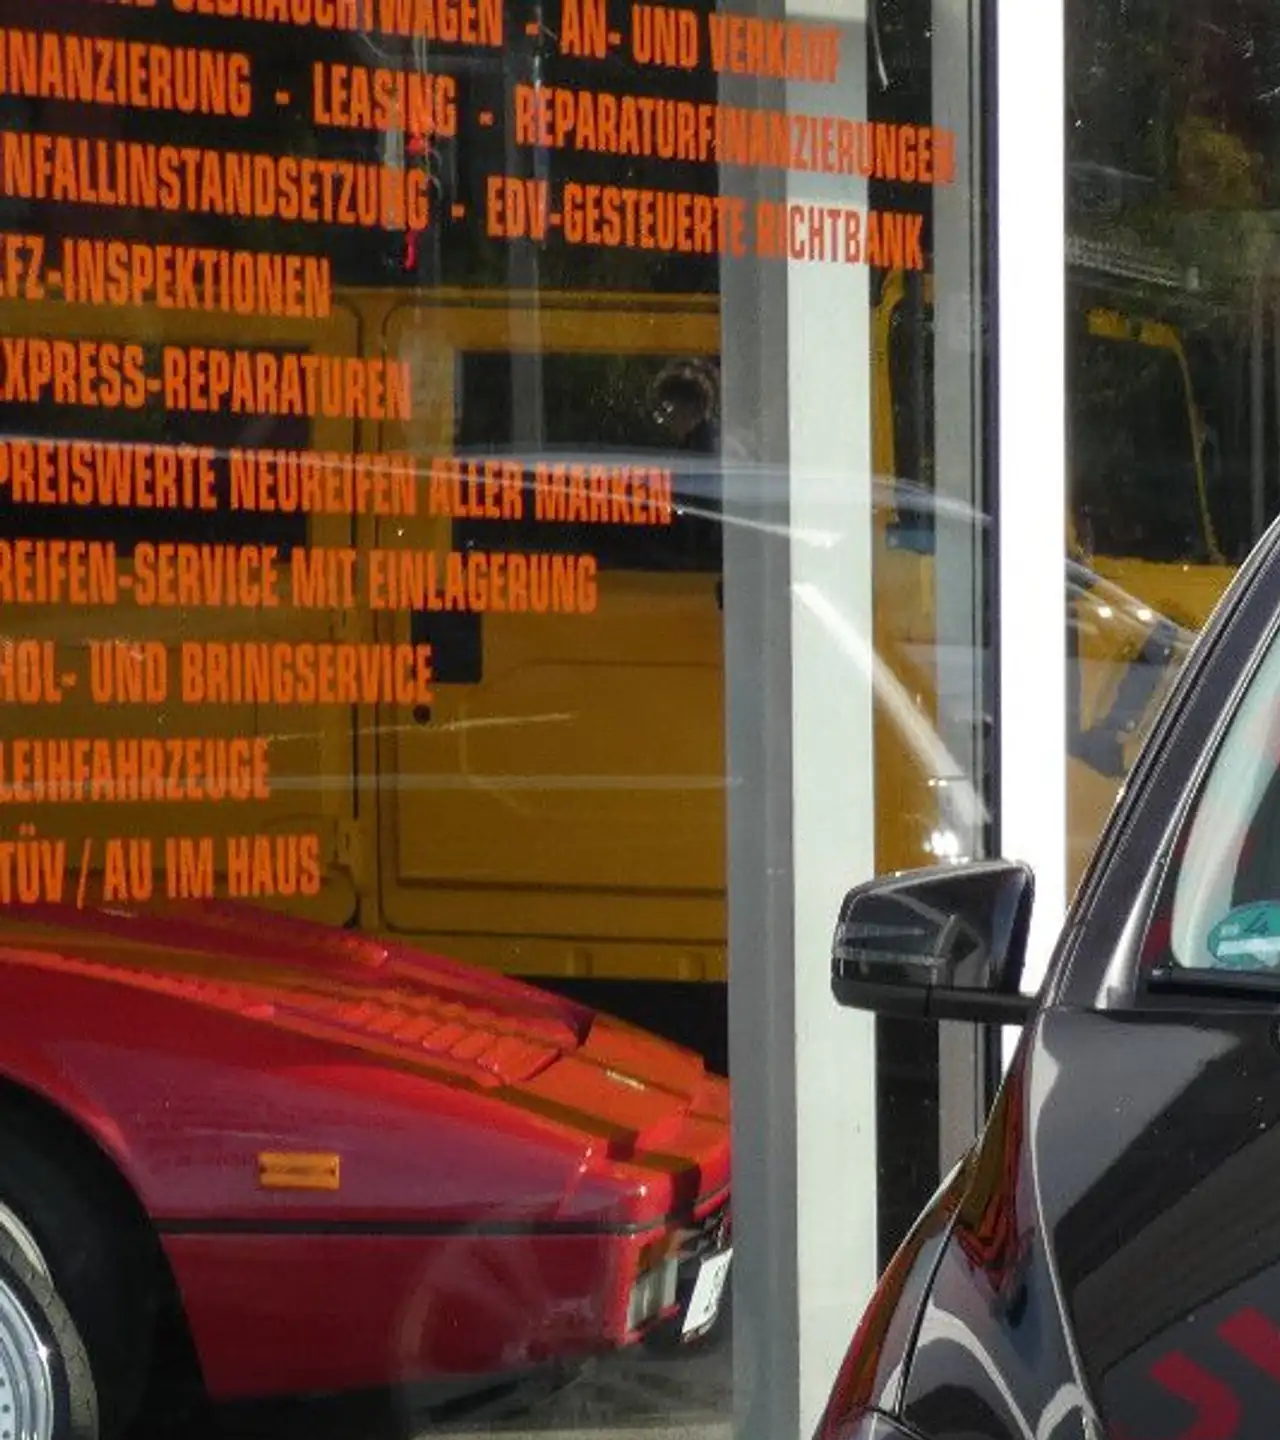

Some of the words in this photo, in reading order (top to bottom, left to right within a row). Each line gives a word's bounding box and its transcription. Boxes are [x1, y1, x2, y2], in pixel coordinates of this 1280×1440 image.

[632, 4, 698, 69] UND
[708, 13, 842, 83] VERKAUF
[313, 62, 456, 137] LEASING
[514, 84, 956, 184] REPARATURFINANZIERUNGEN
[0, 131, 429, 230] NFALLINSTANDSETZUNG
[487, 176, 746, 257] EDV-GESTEUERTE
[756, 200, 923, 270] RICHTBANK
[0, 233, 331, 318] FZ-INSPEKTIONEN
[0, 336, 412, 420] XPRESS-REPARATUREN
[0, 438, 217, 509] PREISWERTE
[230, 447, 416, 515] NEUREIFEN
[429, 456, 524, 520] ALLER
[534, 461, 672, 525] MARKEN
[291, 546, 357, 610] MIT
[369, 548, 598, 614] EINLAGERUNG
[89, 640, 168, 704] UND
[182, 643, 434, 704] BRINGSERVICE
[104, 837, 153, 901] AU
[165, 836, 214, 898] IM
[227, 834, 321, 897] HAUS
